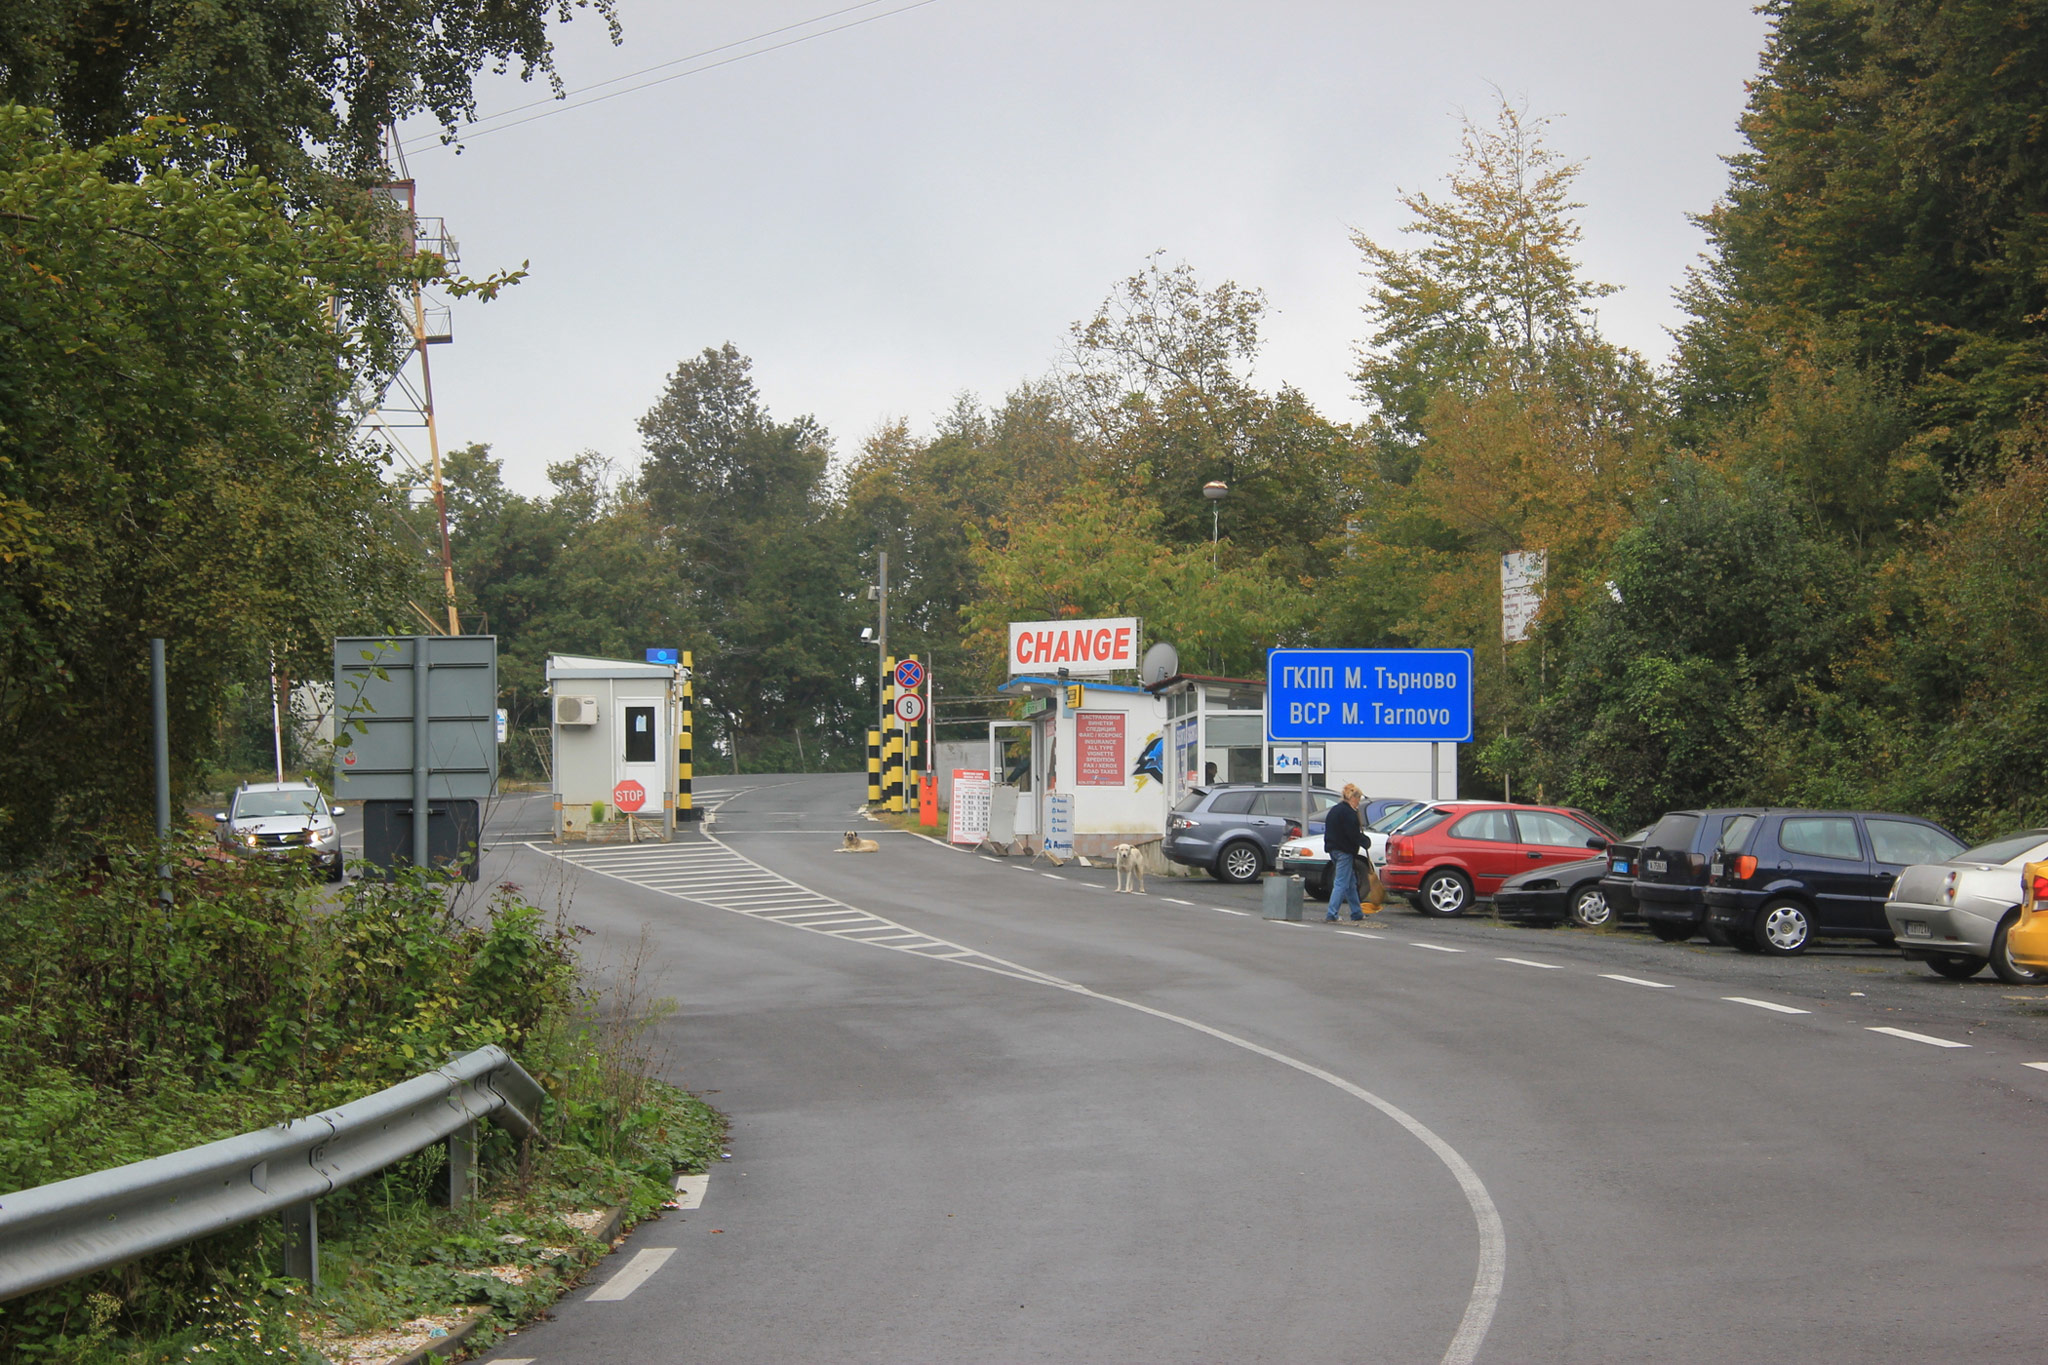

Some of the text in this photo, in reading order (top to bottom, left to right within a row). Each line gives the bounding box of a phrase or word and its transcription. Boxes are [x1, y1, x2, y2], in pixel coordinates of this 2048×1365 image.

[1016, 628, 1130, 664] CHANGE
[1283, 666, 1456, 695] ГКПП М. Търново
[906, 700, 913, 714] 8
[1290, 702, 1450, 725] BCP M. Tarnovo
[615, 790, 644, 802] STOP
